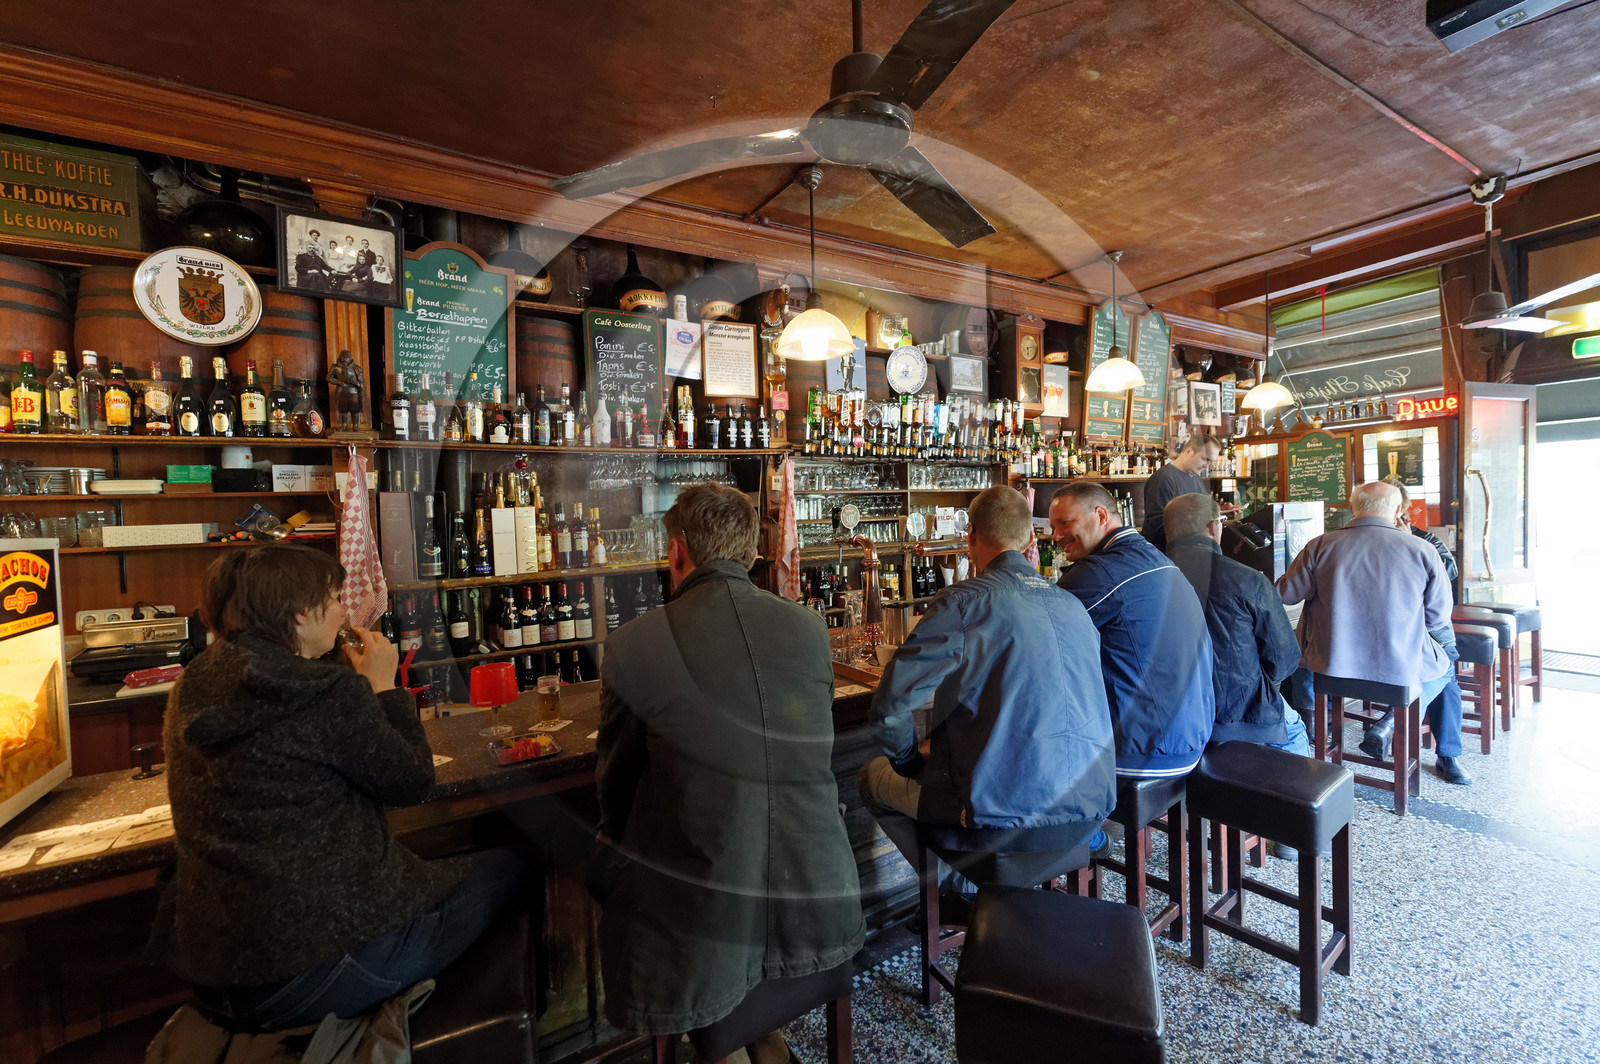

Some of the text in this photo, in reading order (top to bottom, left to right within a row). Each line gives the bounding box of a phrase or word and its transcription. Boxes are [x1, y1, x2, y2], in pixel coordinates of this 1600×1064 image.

[1, 150, 112, 186] THEE KOFFIE
[437, 269, 468, 283] Brand
[416, 297, 440, 308] Brand
[442, 303, 470, 312] PILSENER
[415, 308, 488, 325] Borrelhappen
[397, 321, 451, 334] Bitterballen
[594, 318, 652, 332] Café Oosterling
[708, 324, 724, 332] Simon
[595, 335, 625, 350] Panini
[708, 332, 727, 340] Meester
[598, 378, 621, 392] Tosti
[13, 397, 35, 413] J&B
[0, 558, 47, 583] ACHOS
